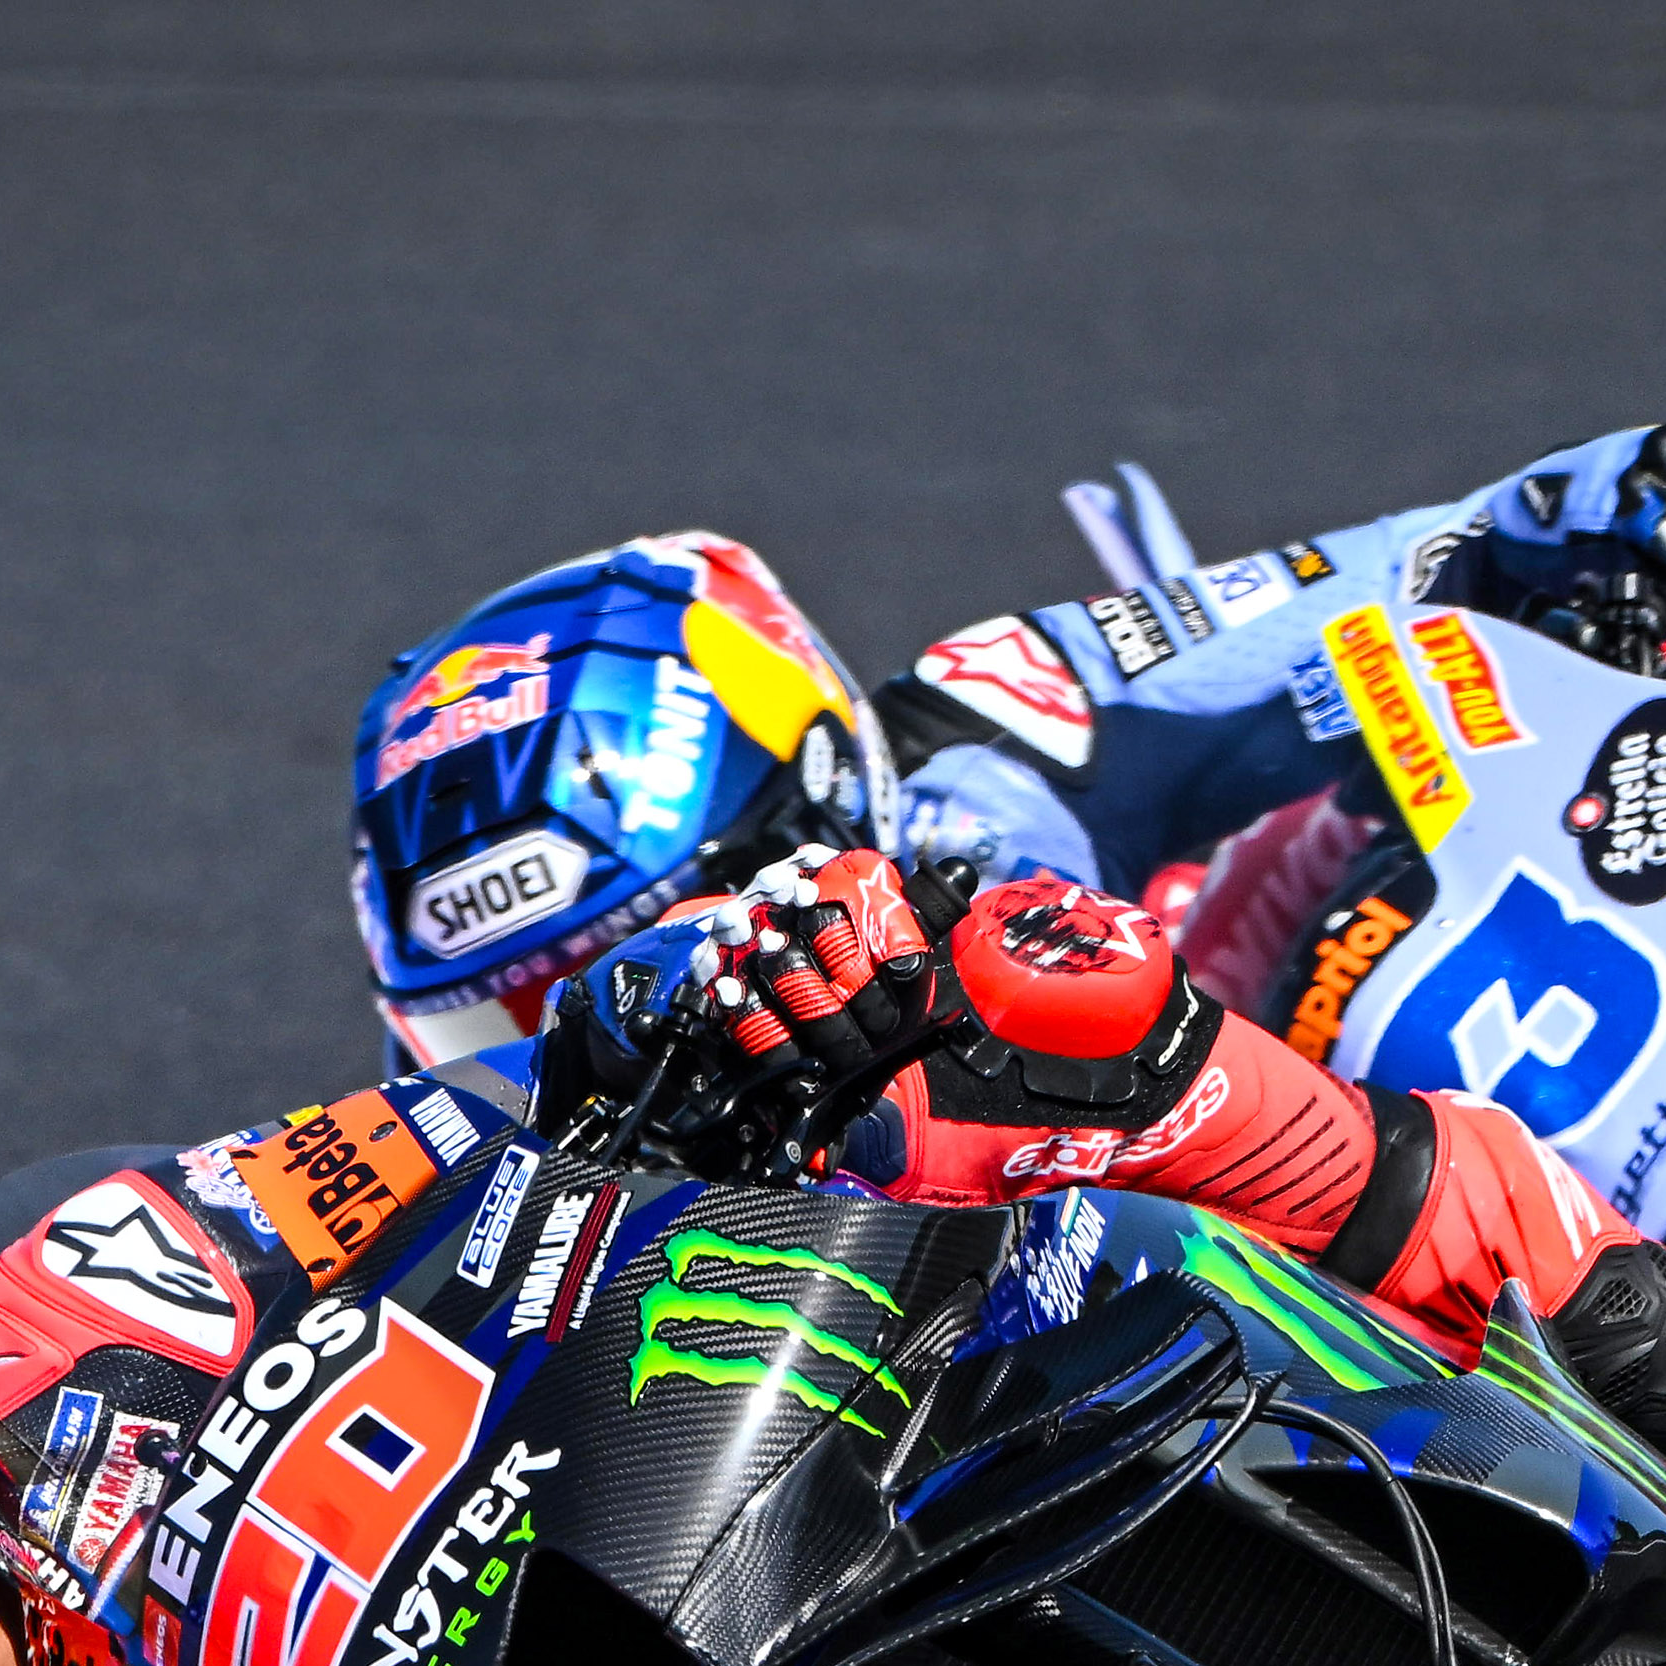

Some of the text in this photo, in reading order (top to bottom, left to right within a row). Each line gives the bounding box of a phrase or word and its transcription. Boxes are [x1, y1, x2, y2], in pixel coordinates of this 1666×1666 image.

[374, 674, 551, 791] Red Bull
[620, 654, 713, 833] TONIT
[1335, 614, 1456, 808] Antangin
[1599, 732, 1651, 874] Estrella
[428, 852, 557, 942] SHOEI
[283, 1112, 379, 1219] Beta
[409, 1087, 481, 1167] YAMAHA
[466, 1160, 515, 1265] BLUE
[482, 1168, 528, 1270] CORE
[507, 1190, 594, 1338] YAMALUBE
[1068, 1196, 1106, 1272] INDIA
[83, 1424, 152, 1532] YAMAHA
[150, 1297, 370, 1607] ENEOS
